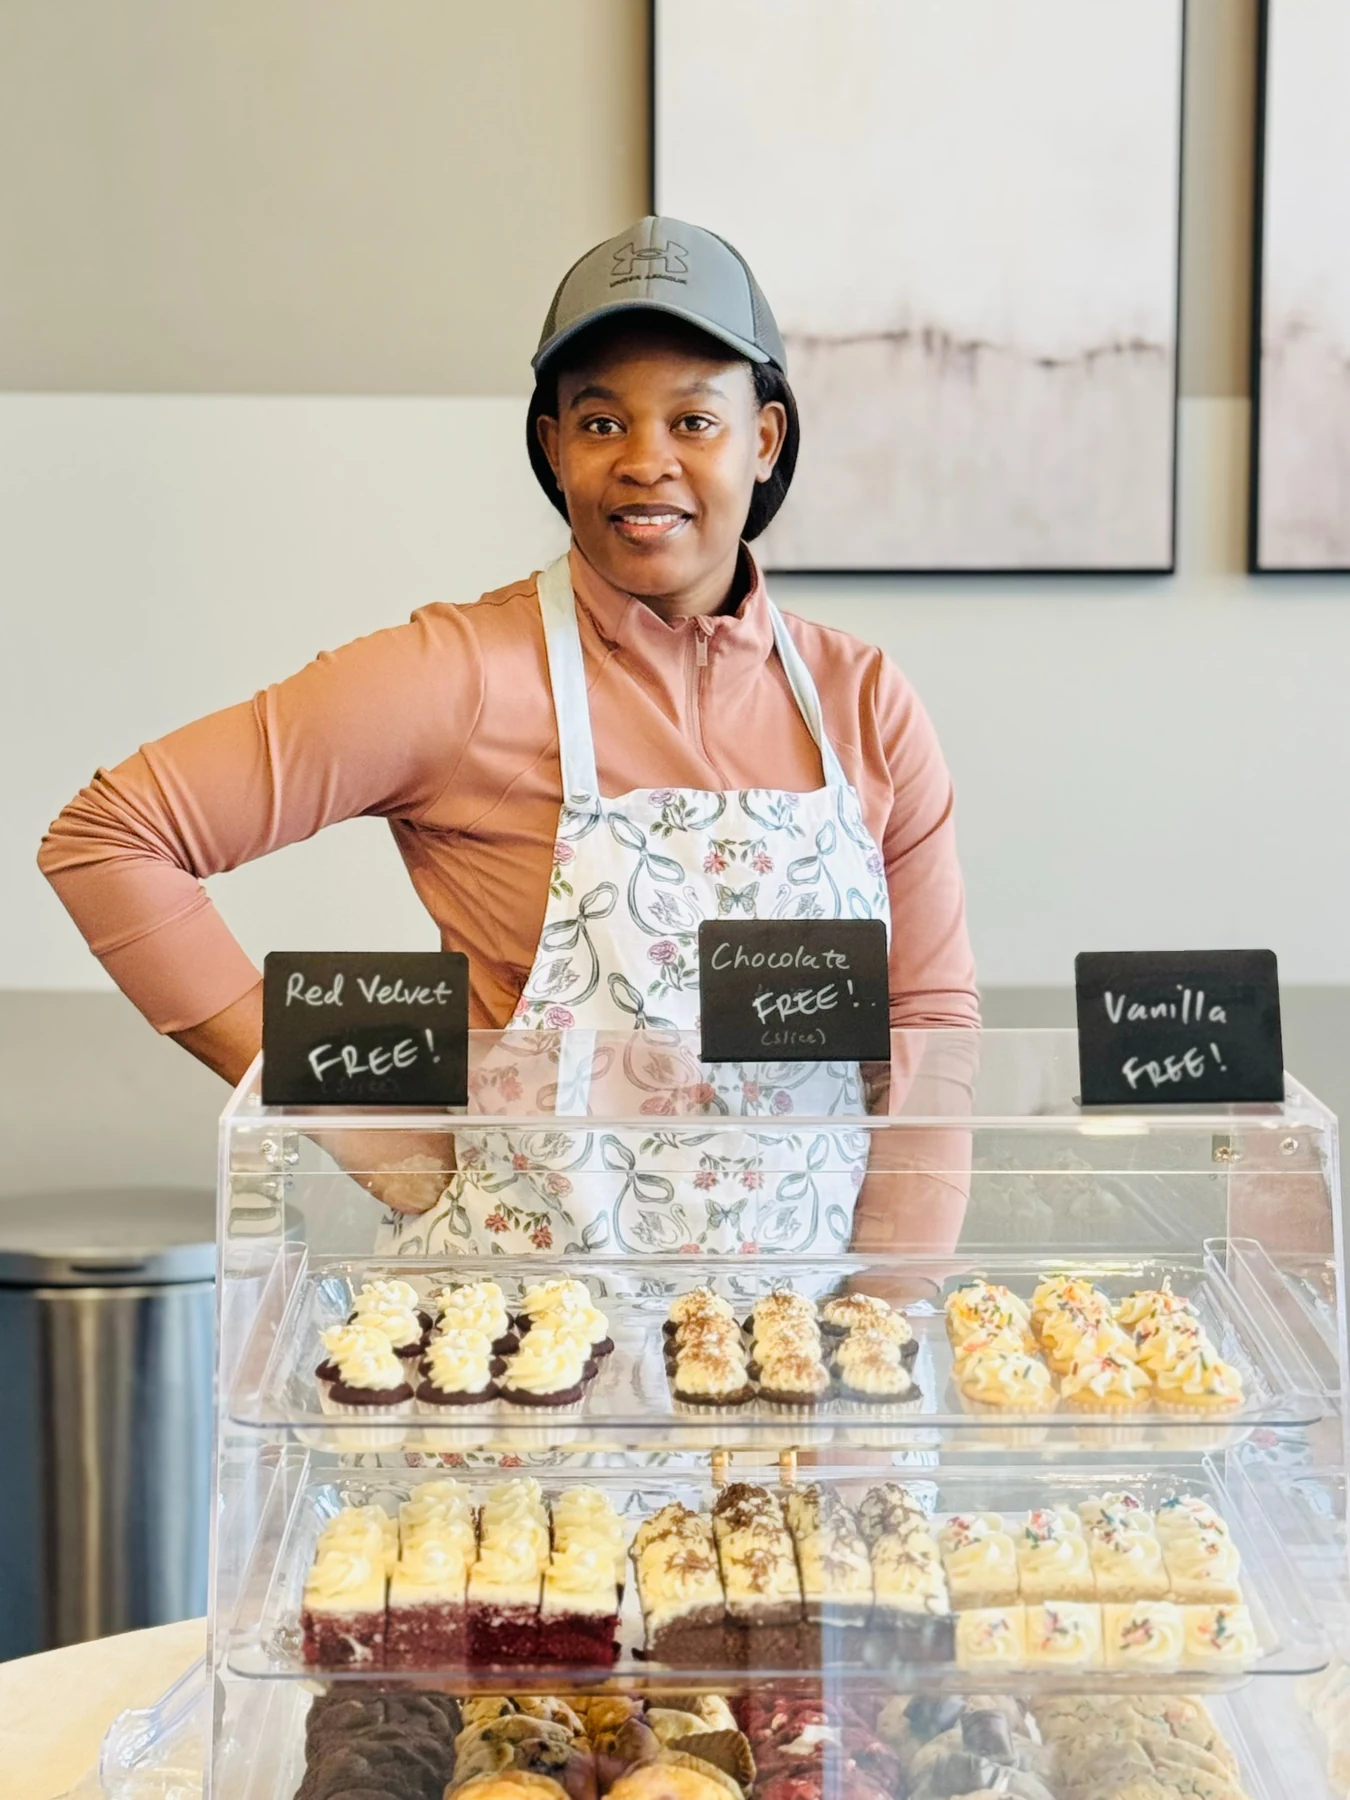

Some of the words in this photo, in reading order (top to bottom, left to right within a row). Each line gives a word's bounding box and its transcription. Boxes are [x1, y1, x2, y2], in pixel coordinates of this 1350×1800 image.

[711, 942, 850, 970] Chocolate
[285, 972, 345, 1007] Red
[356, 974, 453, 1006] Velvet
[1104, 984, 1228, 1025] Vanilla
[308, 1028, 441, 1082] FREE!
[1122, 1042, 1228, 1089] FREE!
